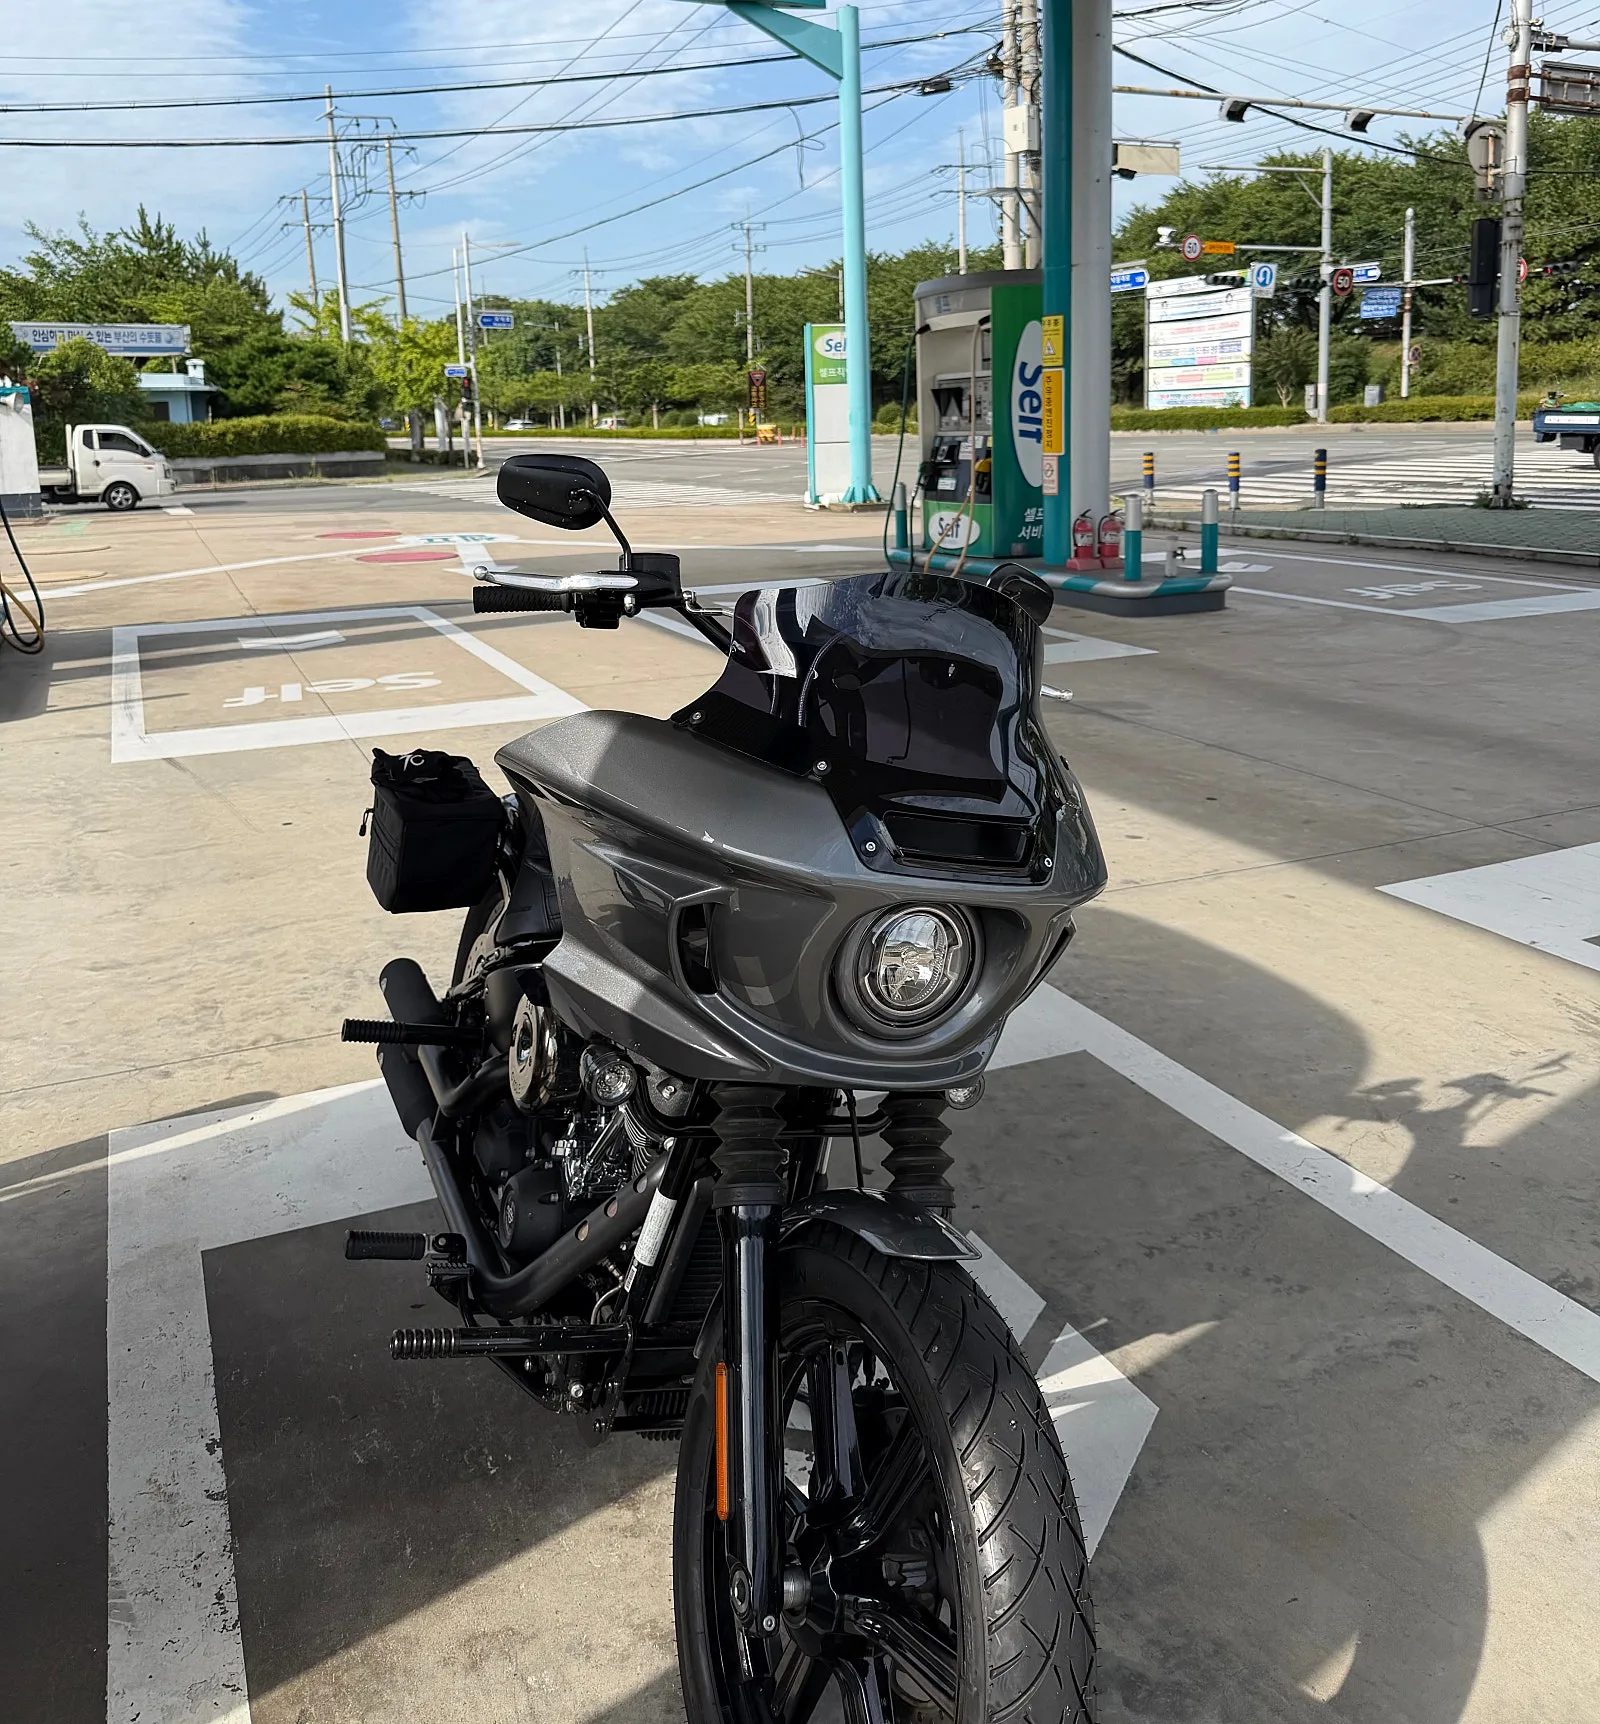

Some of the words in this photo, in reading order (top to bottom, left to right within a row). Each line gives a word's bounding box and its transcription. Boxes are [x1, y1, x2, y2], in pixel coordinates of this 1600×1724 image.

[1187, 242, 1198, 254] 50
[1337, 275, 1350, 288] 50
[32, 329, 65, 343] 안심하고
[86, 331, 94, 341] 수
[96, 331, 112, 343] 있는
[114, 331, 137, 344] 부산의
[139, 331, 162, 344] 수돗물
[825, 338, 846, 352] Sel
[820, 367, 846, 378] 셀프직
[1018, 361, 1043, 444] Self
[1024, 507, 1044, 522] 셀프
[937, 516, 961, 539] Self
[1018, 524, 1044, 540] 서비
